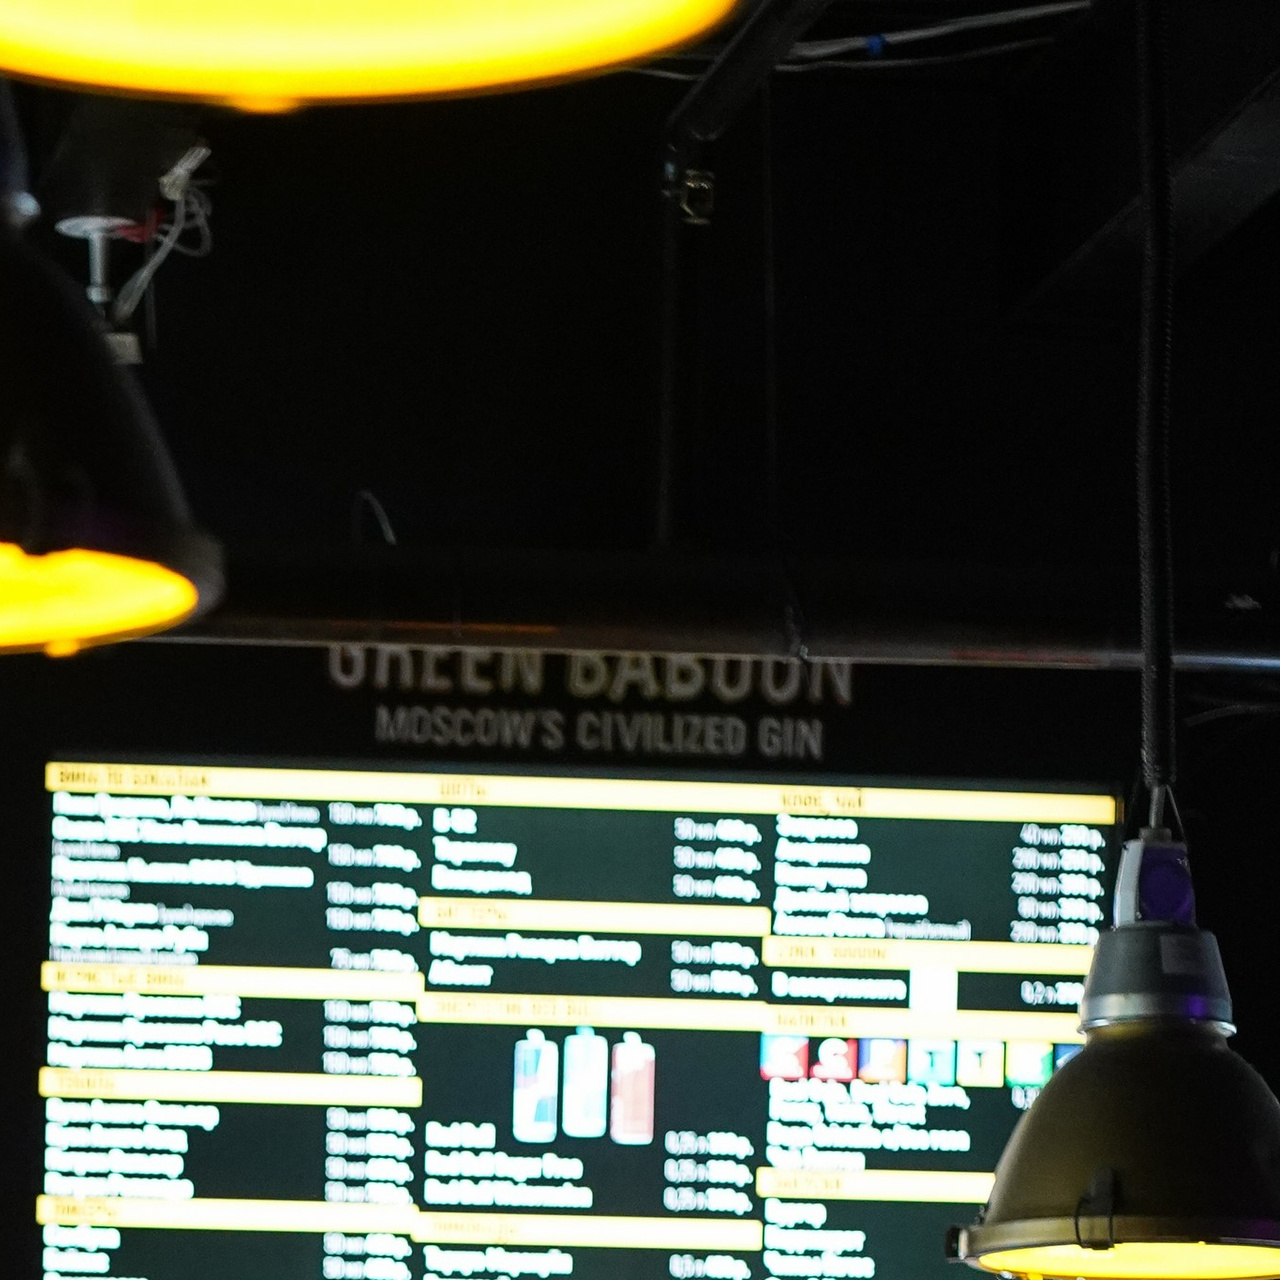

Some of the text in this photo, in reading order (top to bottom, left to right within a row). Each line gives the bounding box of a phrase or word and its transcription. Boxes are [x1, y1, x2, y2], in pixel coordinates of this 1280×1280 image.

[375, 704, 823, 760] MOSCOW'S CIVILIZED GIN
